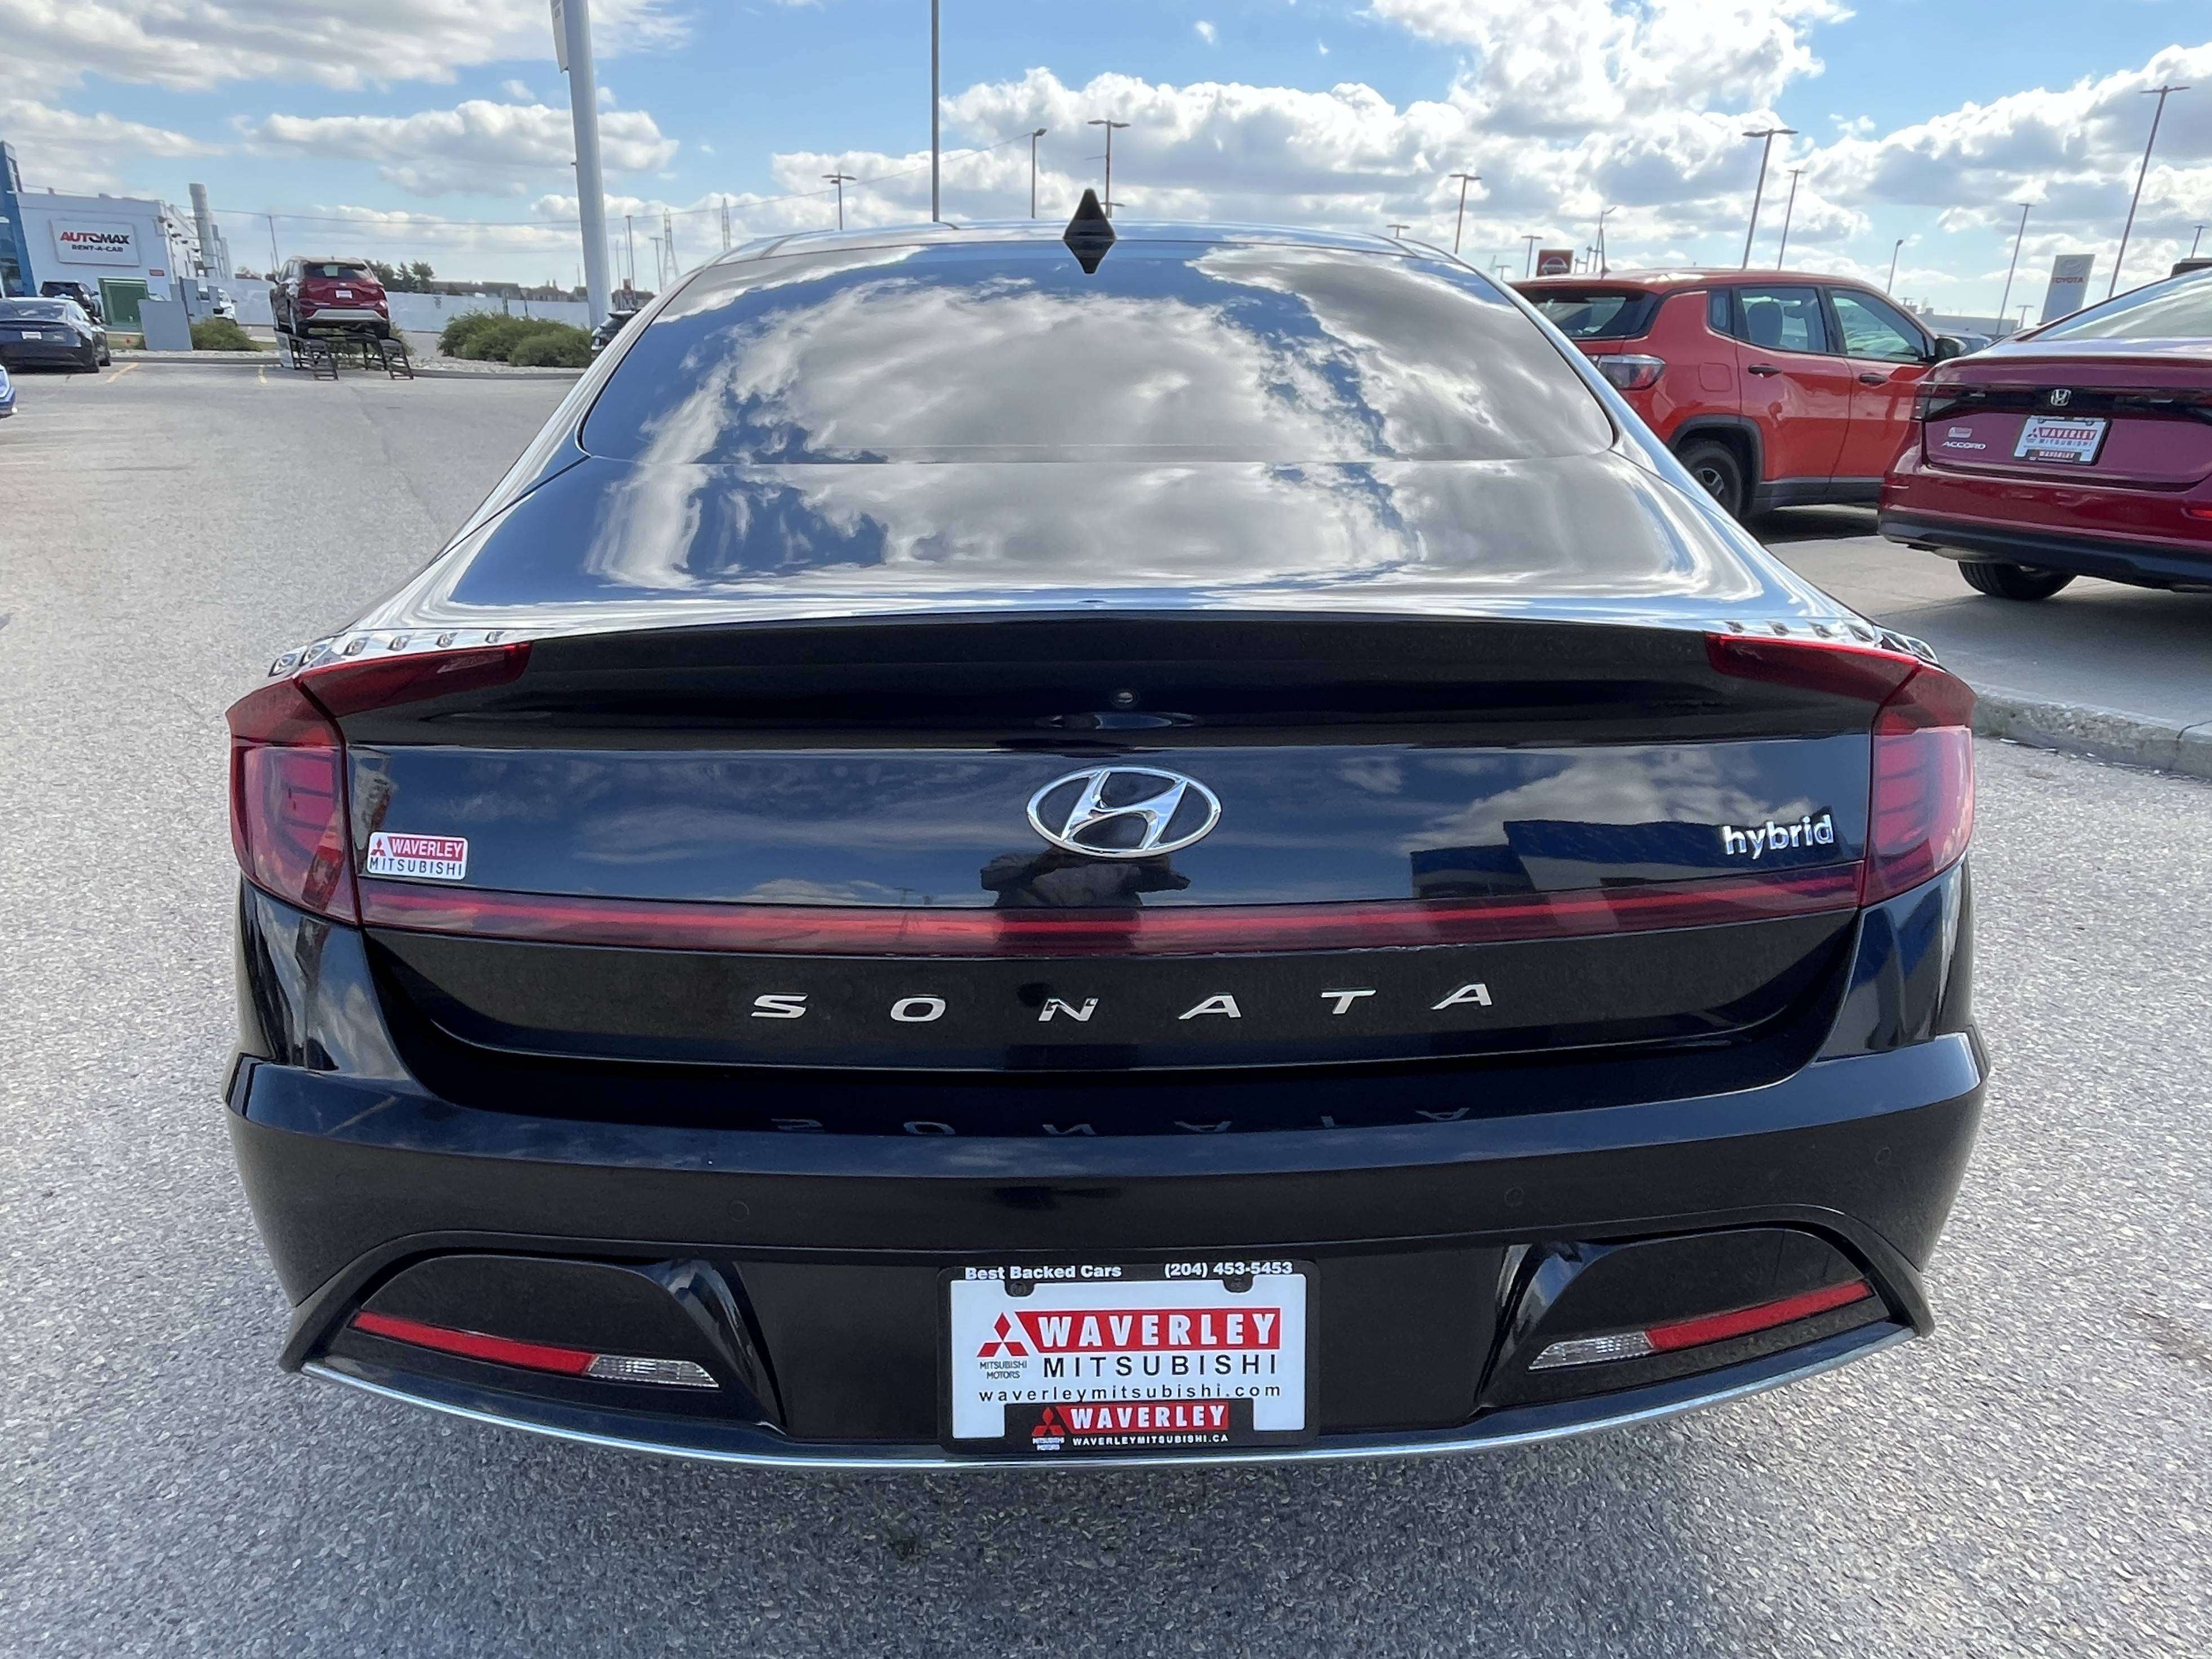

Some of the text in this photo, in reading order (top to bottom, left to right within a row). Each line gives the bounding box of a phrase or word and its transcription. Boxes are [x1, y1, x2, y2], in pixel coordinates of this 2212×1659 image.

[60, 232, 130, 244] AUTOMAX
[72, 244, 124, 252] RENT-A-CAR
[2041, 428, 2097, 439] WAVERLEY
[1941, 441, 1986, 450] ACCORD
[1722, 814, 1835, 860] hybrid
[391, 838, 464, 859] WAVERLEY
[370, 857, 462, 876] MITSUBISHI
[751, 984, 1492, 1022] SONATA
[964, 1261, 1293, 1280] Best Backed Cars (204) 453-5453
[1038, 1313, 1275, 1347] WAVERLEY
[979, 1360, 1027, 1369] MITSUBISHI
[1043, 1354, 1276, 1378] MITSUBISHI
[986, 1370, 1021, 1380] MOTORS
[978, 1383, 1280, 1402] waverleymitsubishi.com
[1070, 1405, 1225, 1429] WAVERLEY
[1072, 1434, 1229, 1447] WAVERLEYMITSUBISHI.CA
